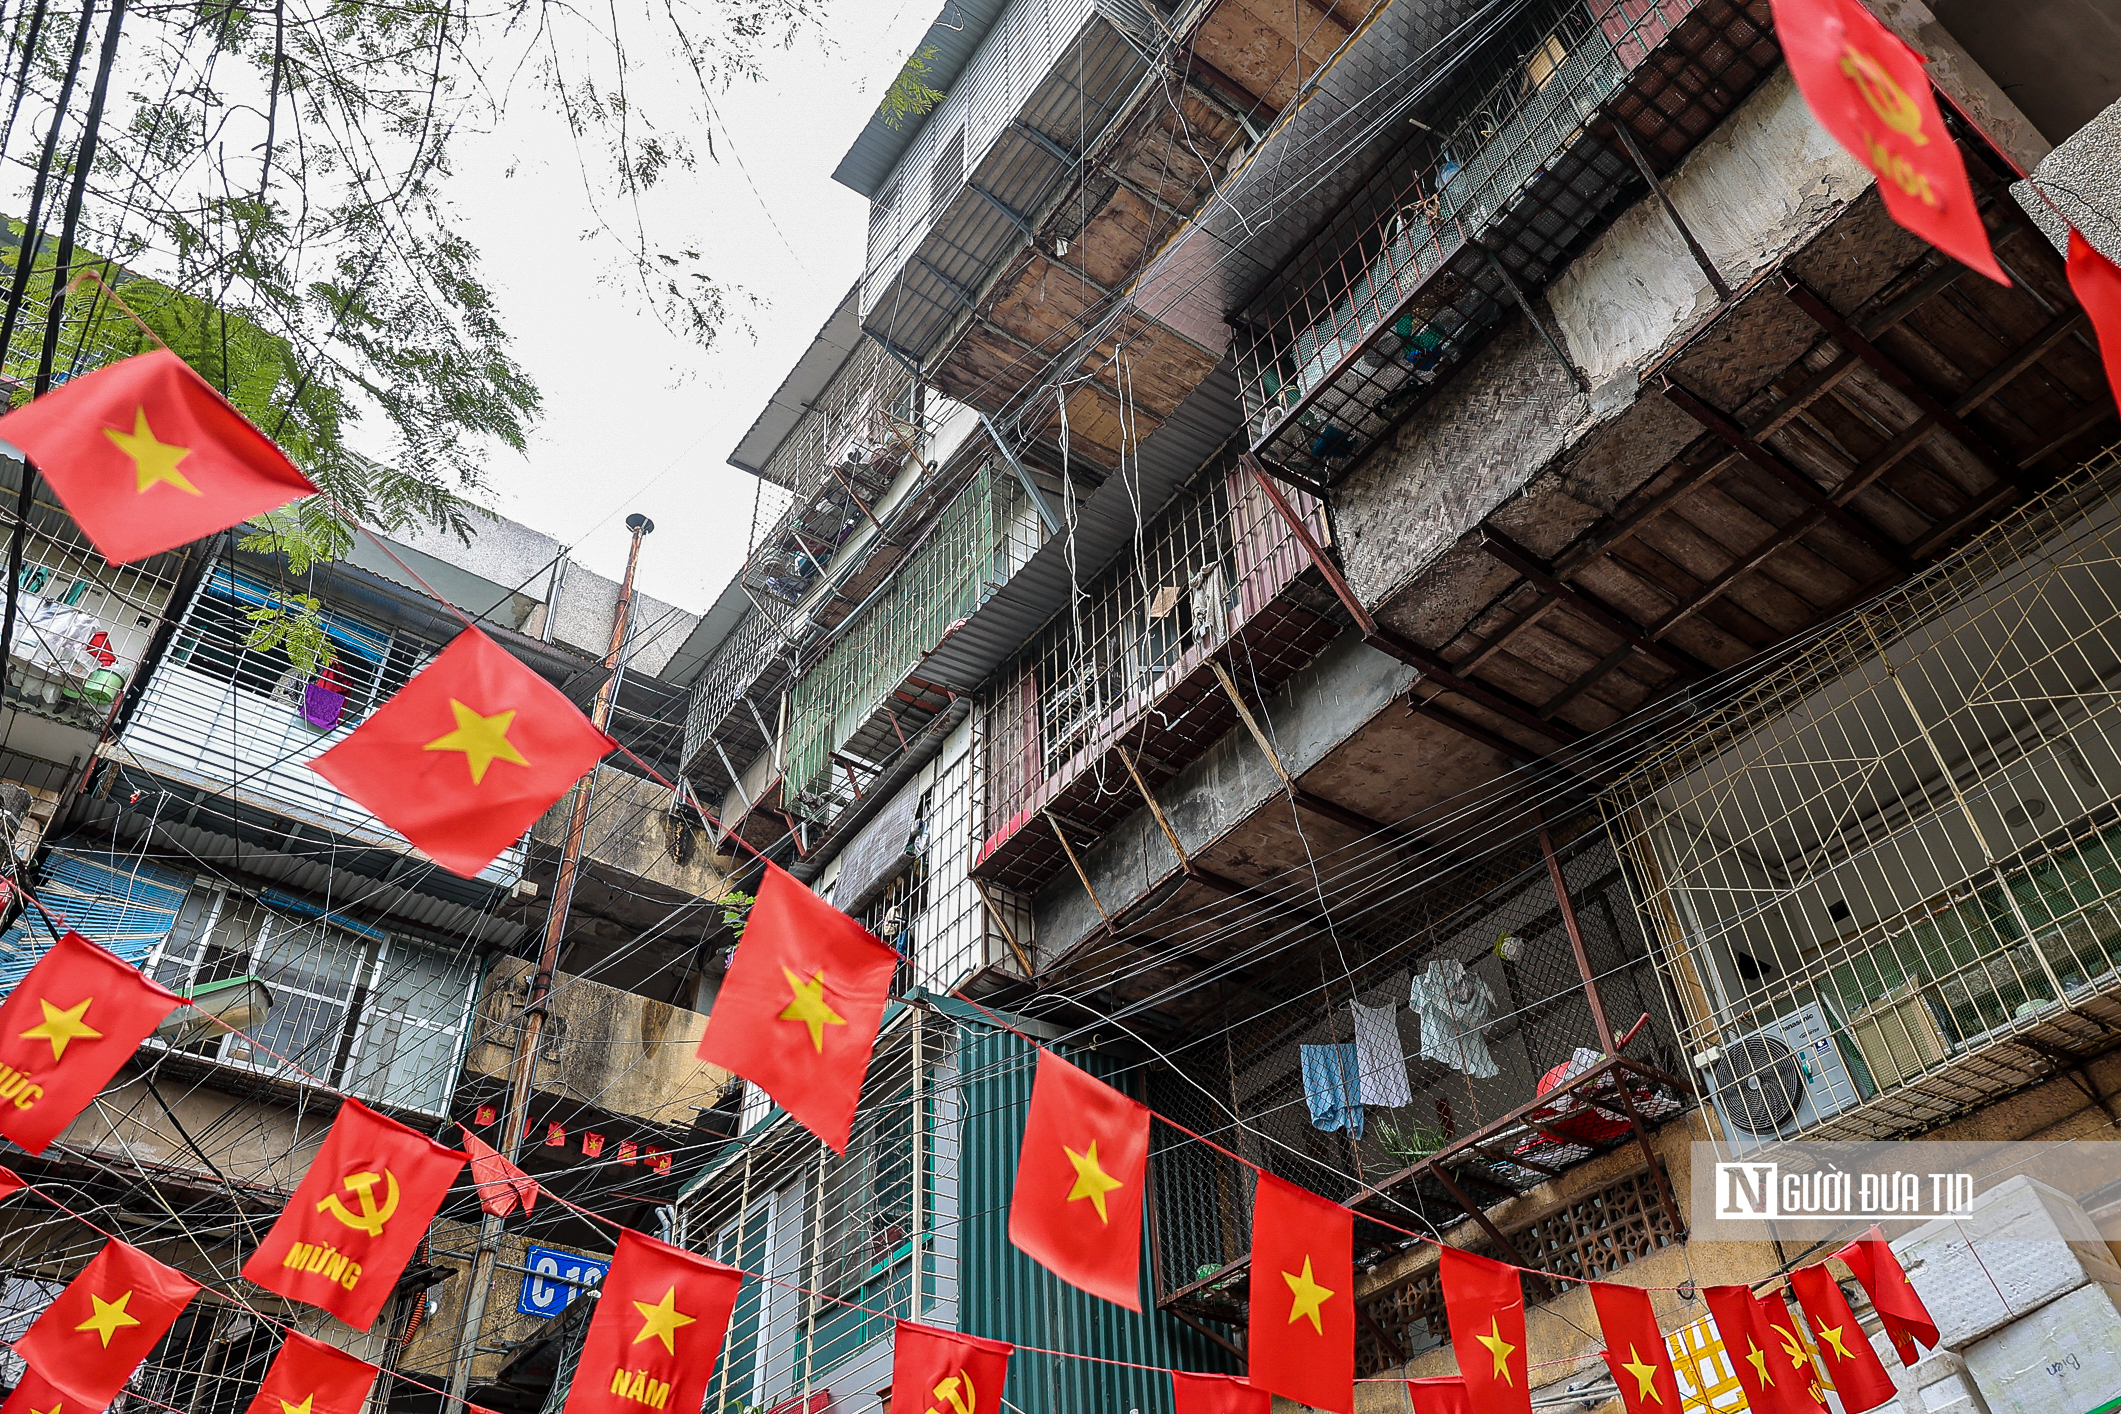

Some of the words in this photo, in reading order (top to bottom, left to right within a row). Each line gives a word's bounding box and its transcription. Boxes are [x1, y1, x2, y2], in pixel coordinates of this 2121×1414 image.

[1778, 1012, 1815, 1035] Panasnic
[282, 1240, 363, 1291] MỪNG
[532, 1257, 558, 1308] C
[610, 1367, 671, 1411] NĂM
